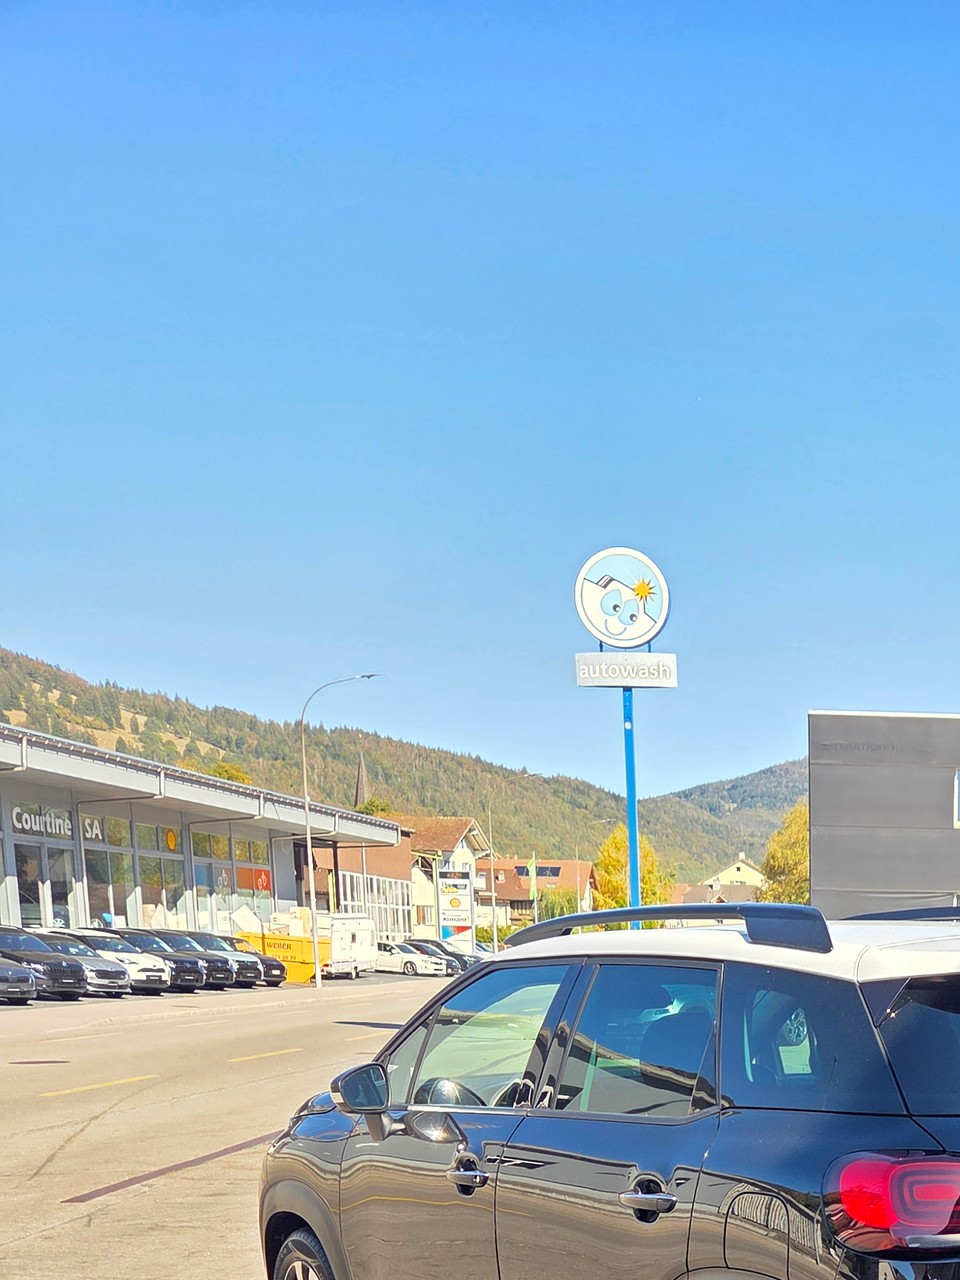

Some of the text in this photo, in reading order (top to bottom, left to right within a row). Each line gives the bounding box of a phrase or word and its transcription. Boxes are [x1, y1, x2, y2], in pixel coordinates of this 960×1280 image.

[579, 661, 671, 679] autowash
[12, 806, 103, 840] Courtine SA
[266, 942, 292, 950] WEBER
